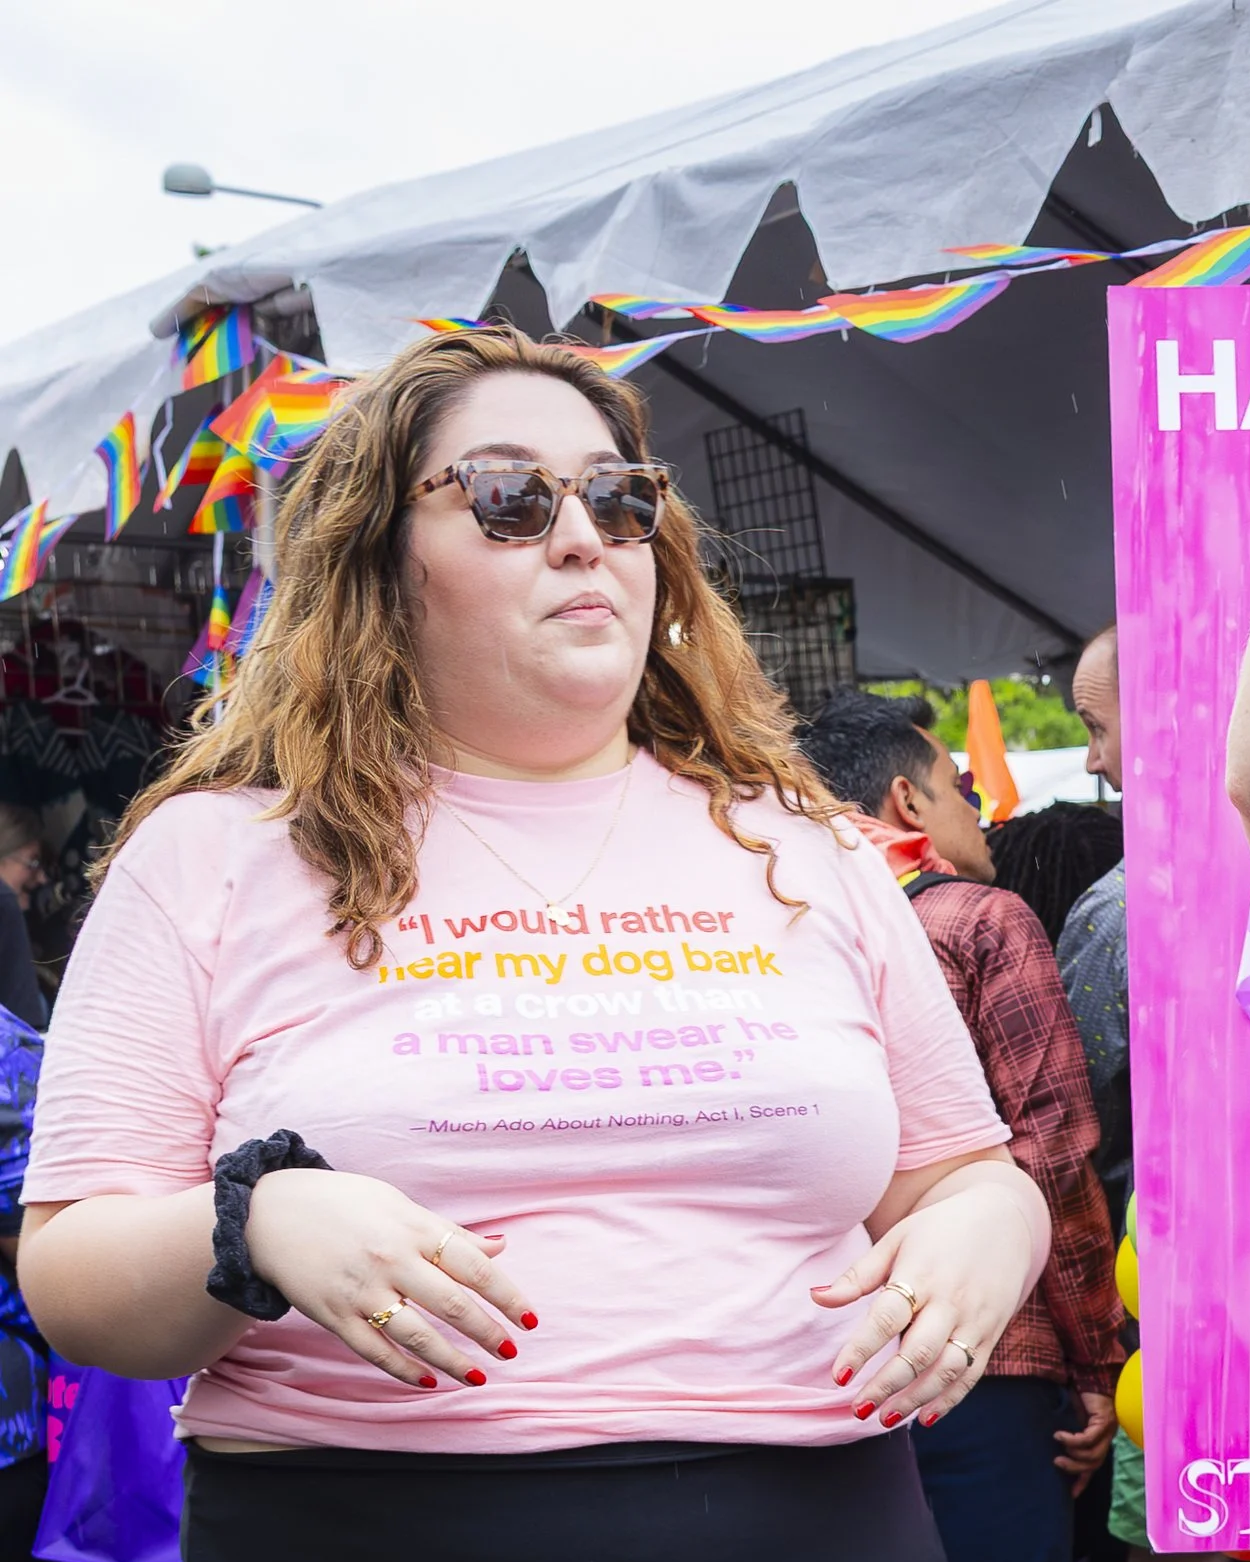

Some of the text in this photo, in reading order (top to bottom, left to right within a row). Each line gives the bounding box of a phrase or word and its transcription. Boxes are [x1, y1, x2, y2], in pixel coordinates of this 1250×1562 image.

[600, 904, 736, 934] rather
[494, 952, 568, 986] my
[582, 943, 675, 982] dog
[680, 942, 784, 977] bark
[414, 981, 764, 1021] at a crow than
[392, 1016, 800, 1056] a man swear he
[476, 1060, 623, 1093] loves
[493, 1119, 536, 1131] Ado
[540, 1117, 601, 1131] About
[608, 1113, 690, 1128] Nothing,
[695, 1110, 729, 1123] Act
[749, 1104, 808, 1119] Scene
